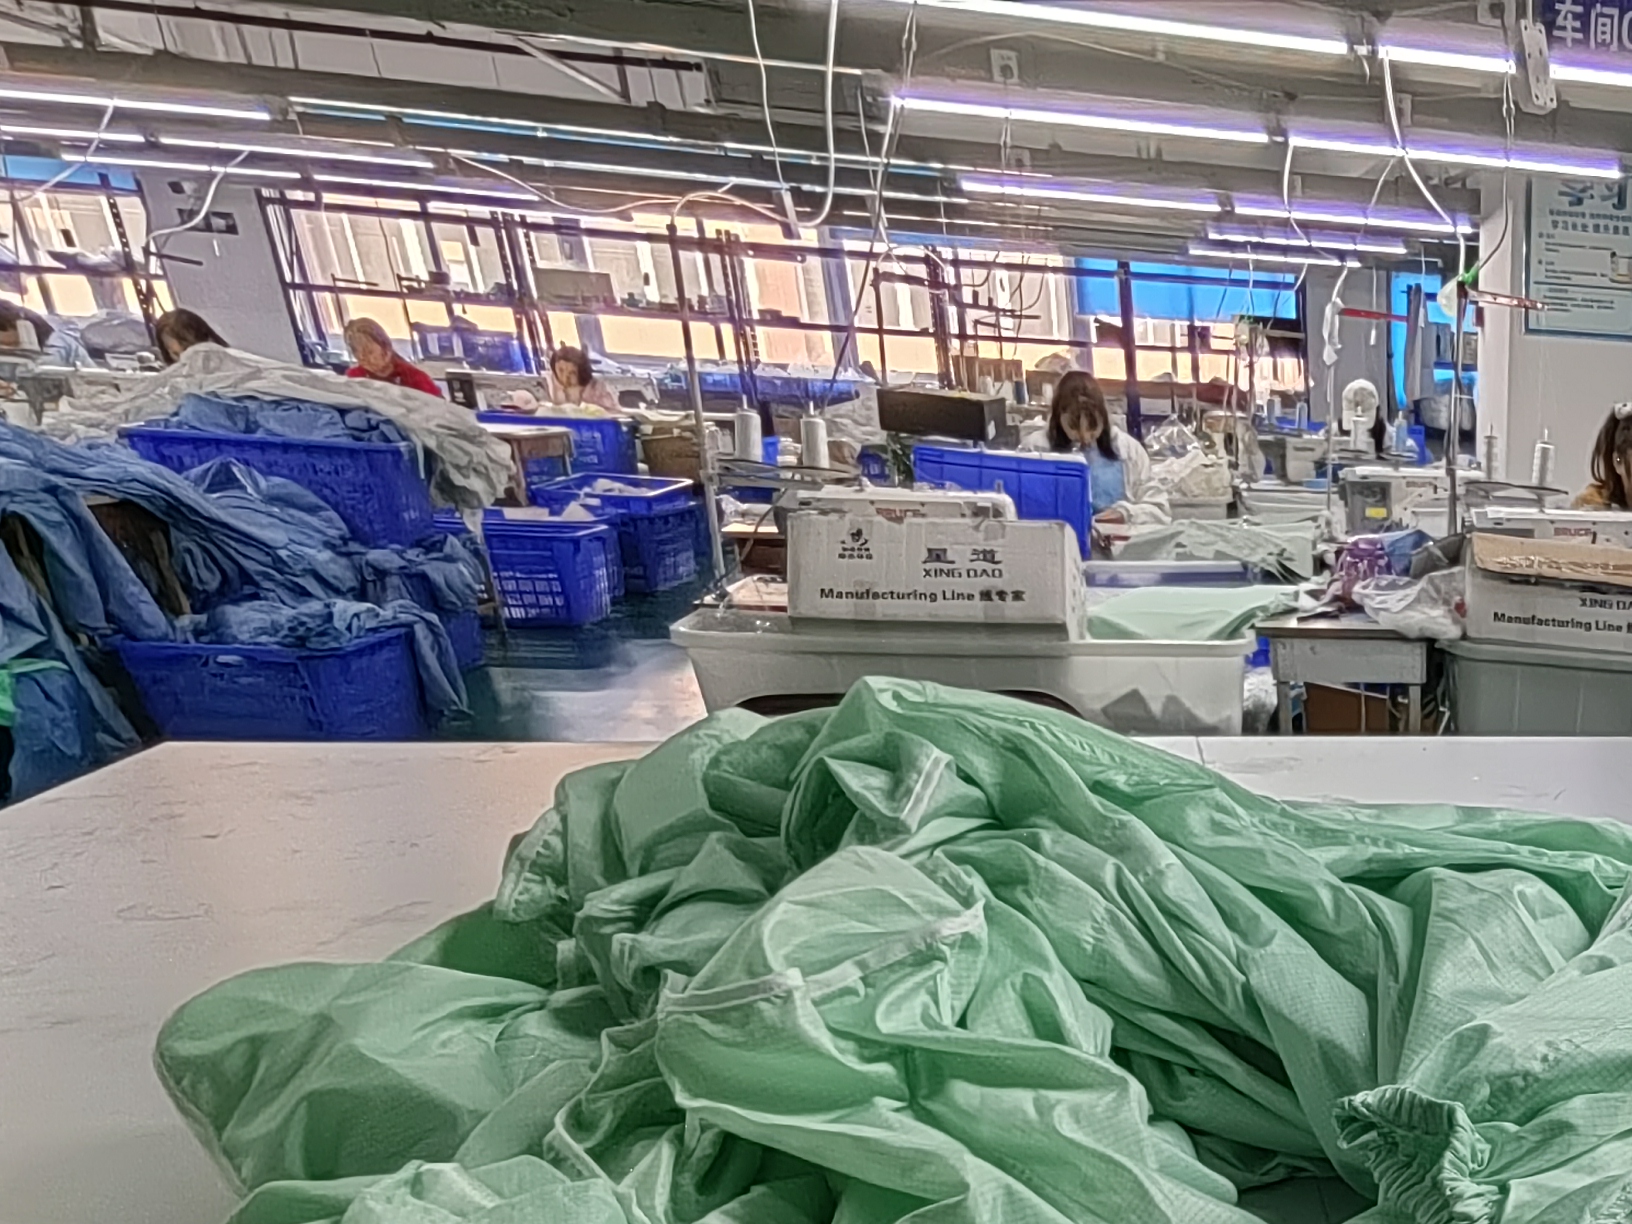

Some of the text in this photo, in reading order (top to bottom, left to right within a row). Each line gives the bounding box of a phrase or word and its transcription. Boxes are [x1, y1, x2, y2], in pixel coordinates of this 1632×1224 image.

[922, 567, 1003, 579] XING DAO
[820, 587, 938, 602] Manufacturing
[942, 589, 975, 601] Line
[1493, 611, 1592, 632] Manufacturing
[1595, 620, 1623, 632] Line
